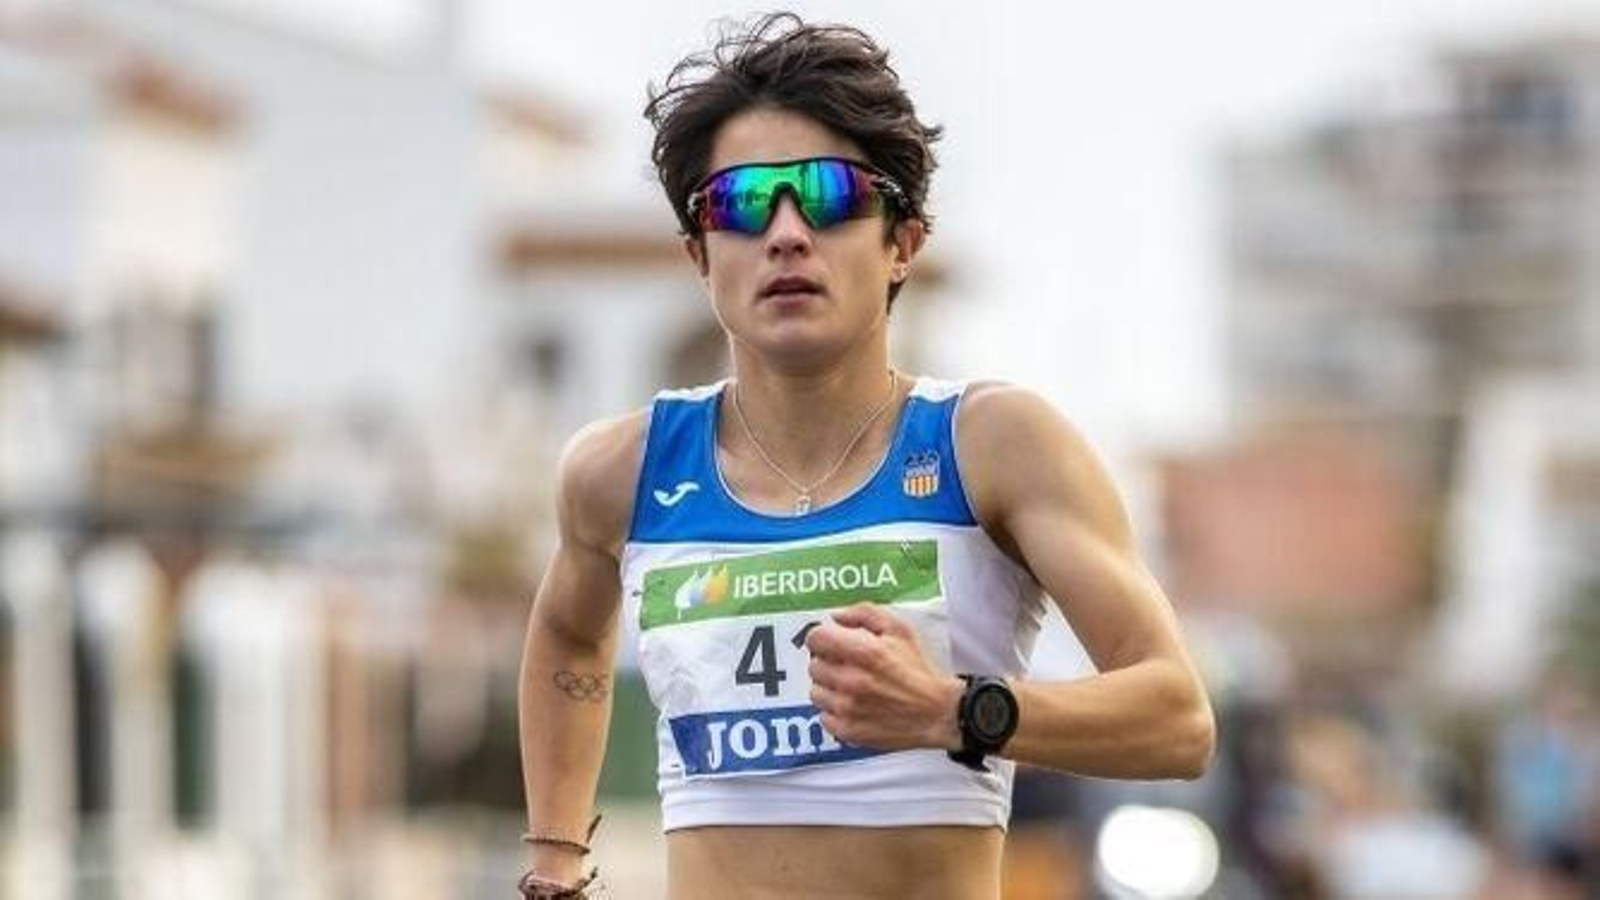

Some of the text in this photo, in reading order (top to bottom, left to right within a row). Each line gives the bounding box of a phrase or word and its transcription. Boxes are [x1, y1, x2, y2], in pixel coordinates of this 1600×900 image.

[733, 562, 898, 598] IBERDROLA
[735, 621, 821, 697] 4
[706, 716, 843, 770] Jom
